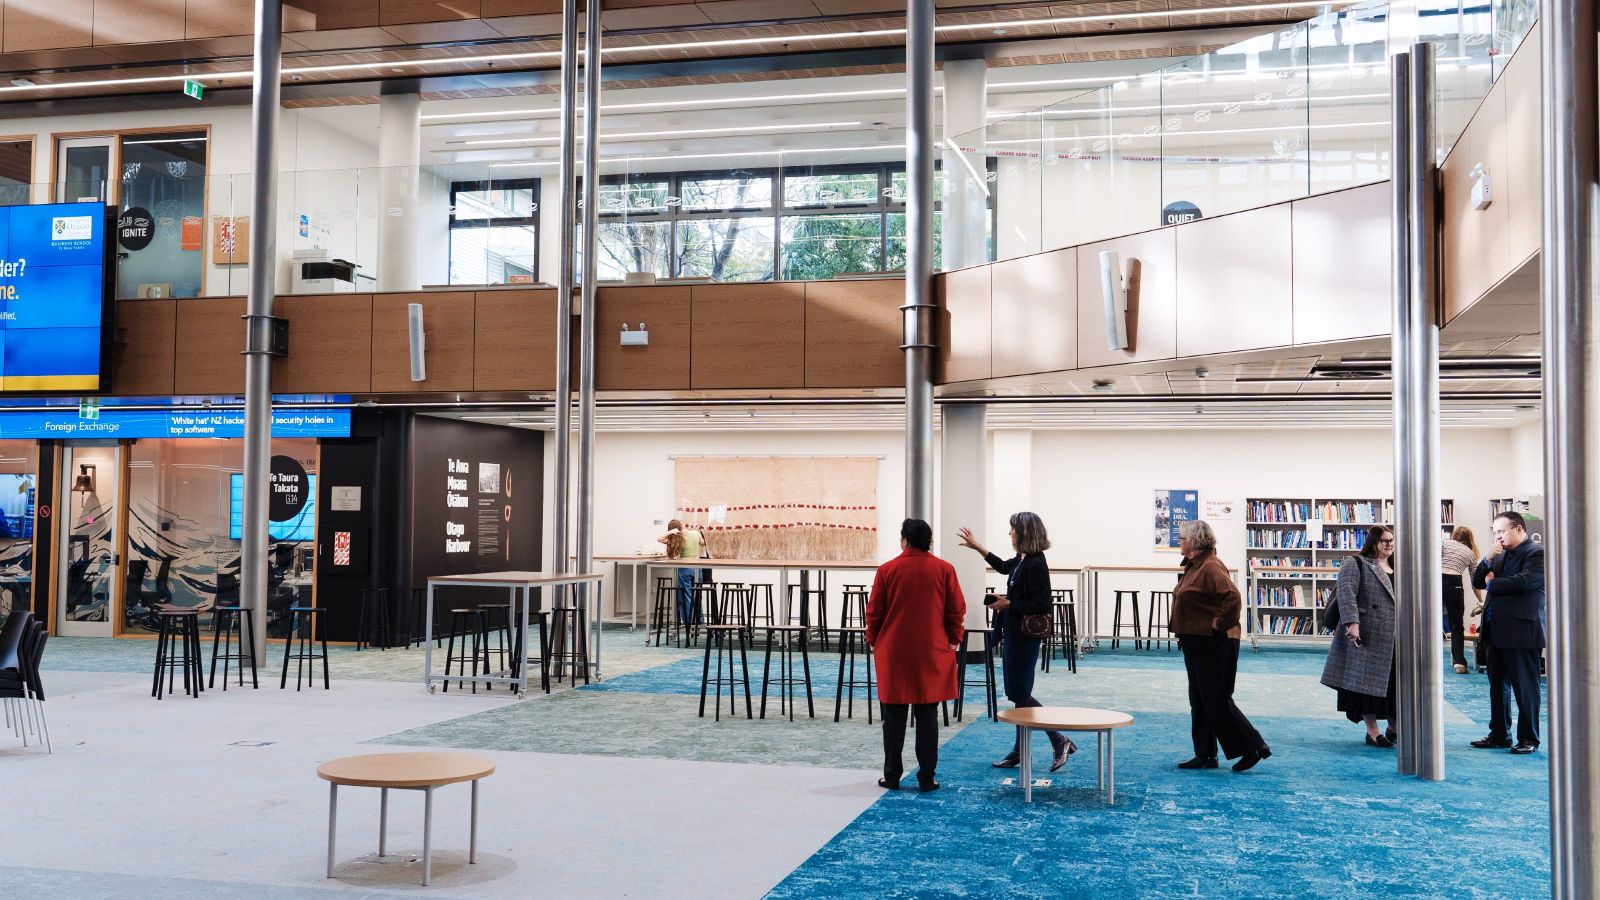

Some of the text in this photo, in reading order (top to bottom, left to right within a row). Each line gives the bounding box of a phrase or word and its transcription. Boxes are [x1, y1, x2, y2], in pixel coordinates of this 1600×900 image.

[1167, 213, 1195, 225] QUIET
[122, 228, 147, 237] IGNITE
[223, 416, 245, 425] hacke
[275, 415, 304, 425] security
[305, 415, 326, 424] holes
[326, 416, 334, 424] in
[45, 420, 120, 434] Foreign Exchange
[170, 426, 215, 436] top software
[448, 458, 469, 473] Te Awa
[269, 473, 299, 482] Te Taura
[448, 476, 467, 490] Moana
[273, 483, 299, 493] Takata
[447, 521, 464, 537] Otago
[446, 539, 470, 553] Harbour
